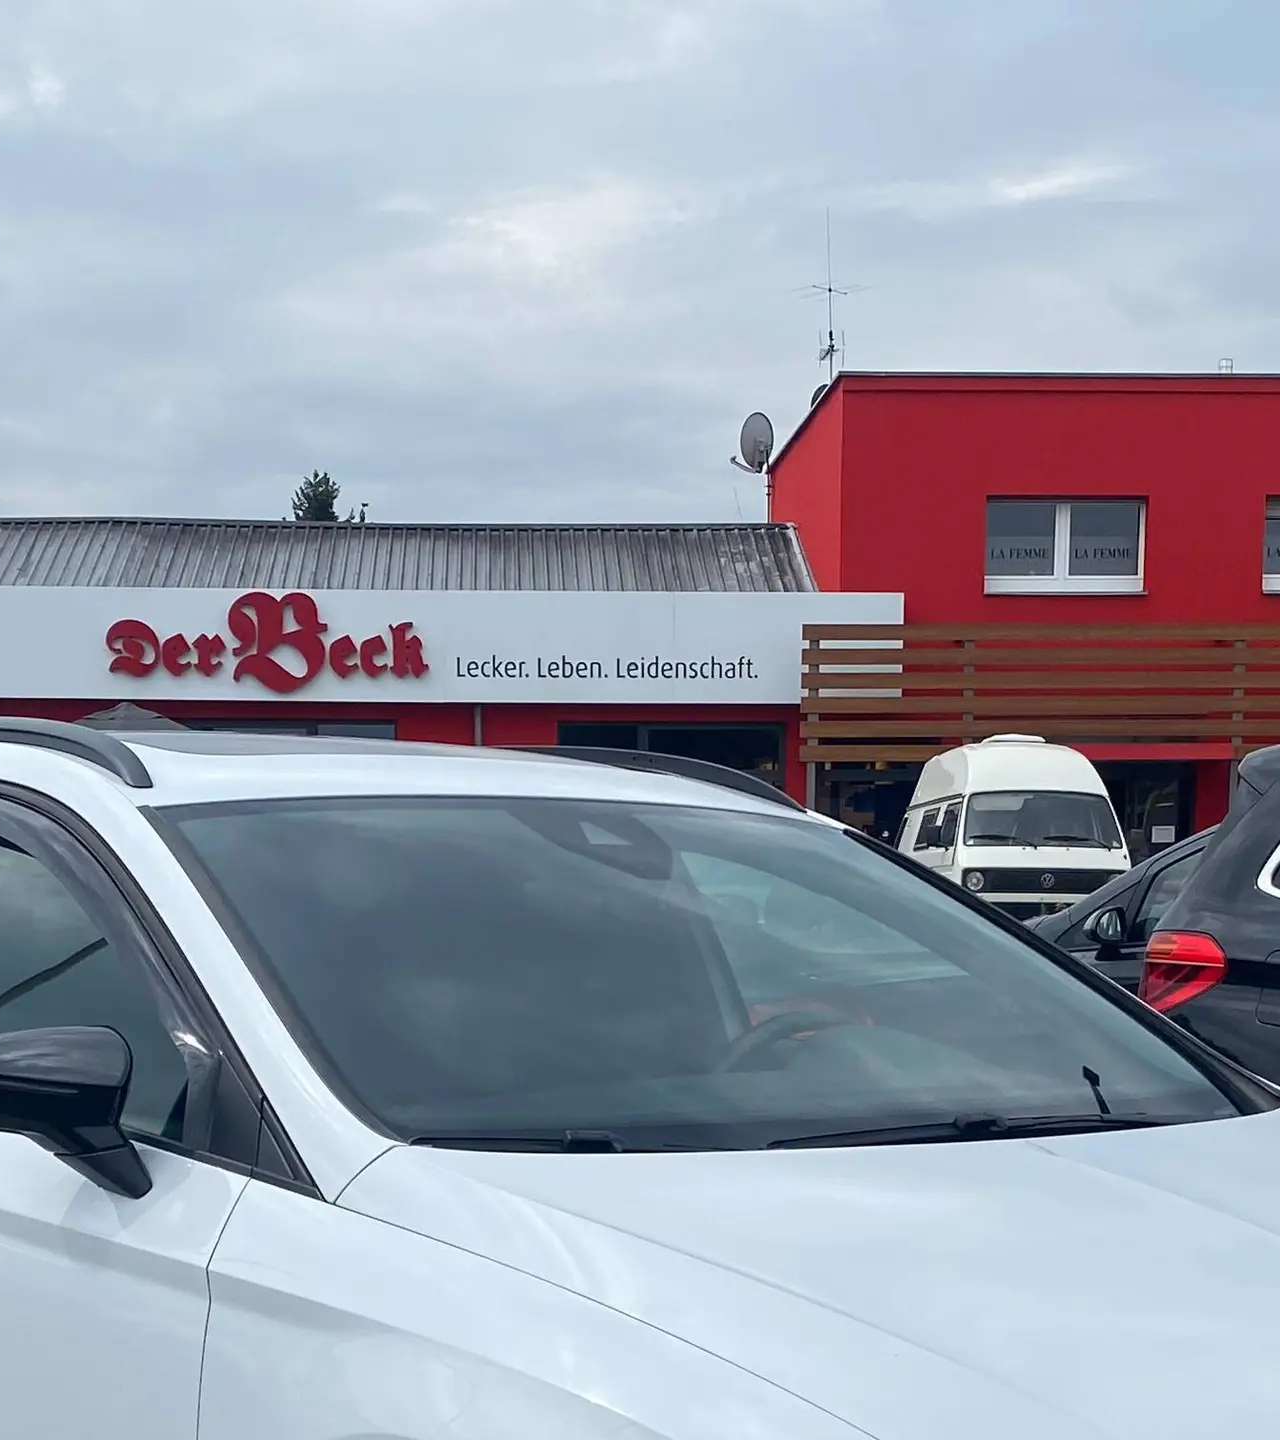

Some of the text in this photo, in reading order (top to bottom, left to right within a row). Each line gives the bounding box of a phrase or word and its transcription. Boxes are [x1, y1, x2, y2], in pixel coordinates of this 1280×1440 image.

[990, 548, 1049, 560] LA FEMME
[1074, 548, 1132, 560] LA FEMME
[1266, 547, 1280, 558] LA
[456, 655, 759, 679] Lecker. Leben. Leidenschaft.
